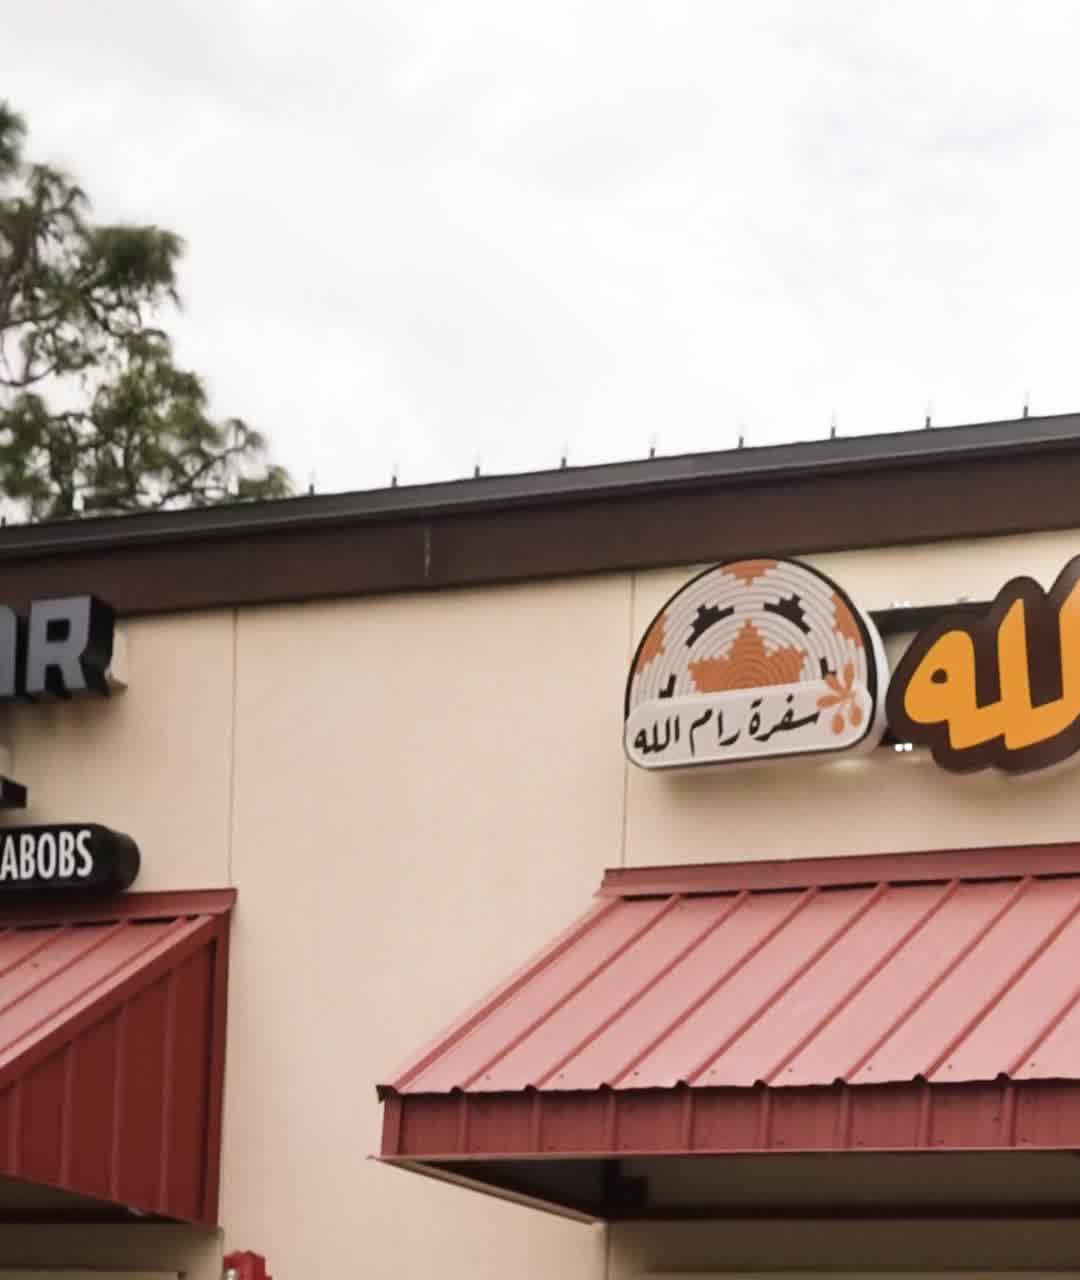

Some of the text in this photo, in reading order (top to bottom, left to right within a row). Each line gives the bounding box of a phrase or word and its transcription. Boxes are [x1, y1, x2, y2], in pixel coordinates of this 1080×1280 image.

[633, 693, 821, 757] سفرة رام الله
